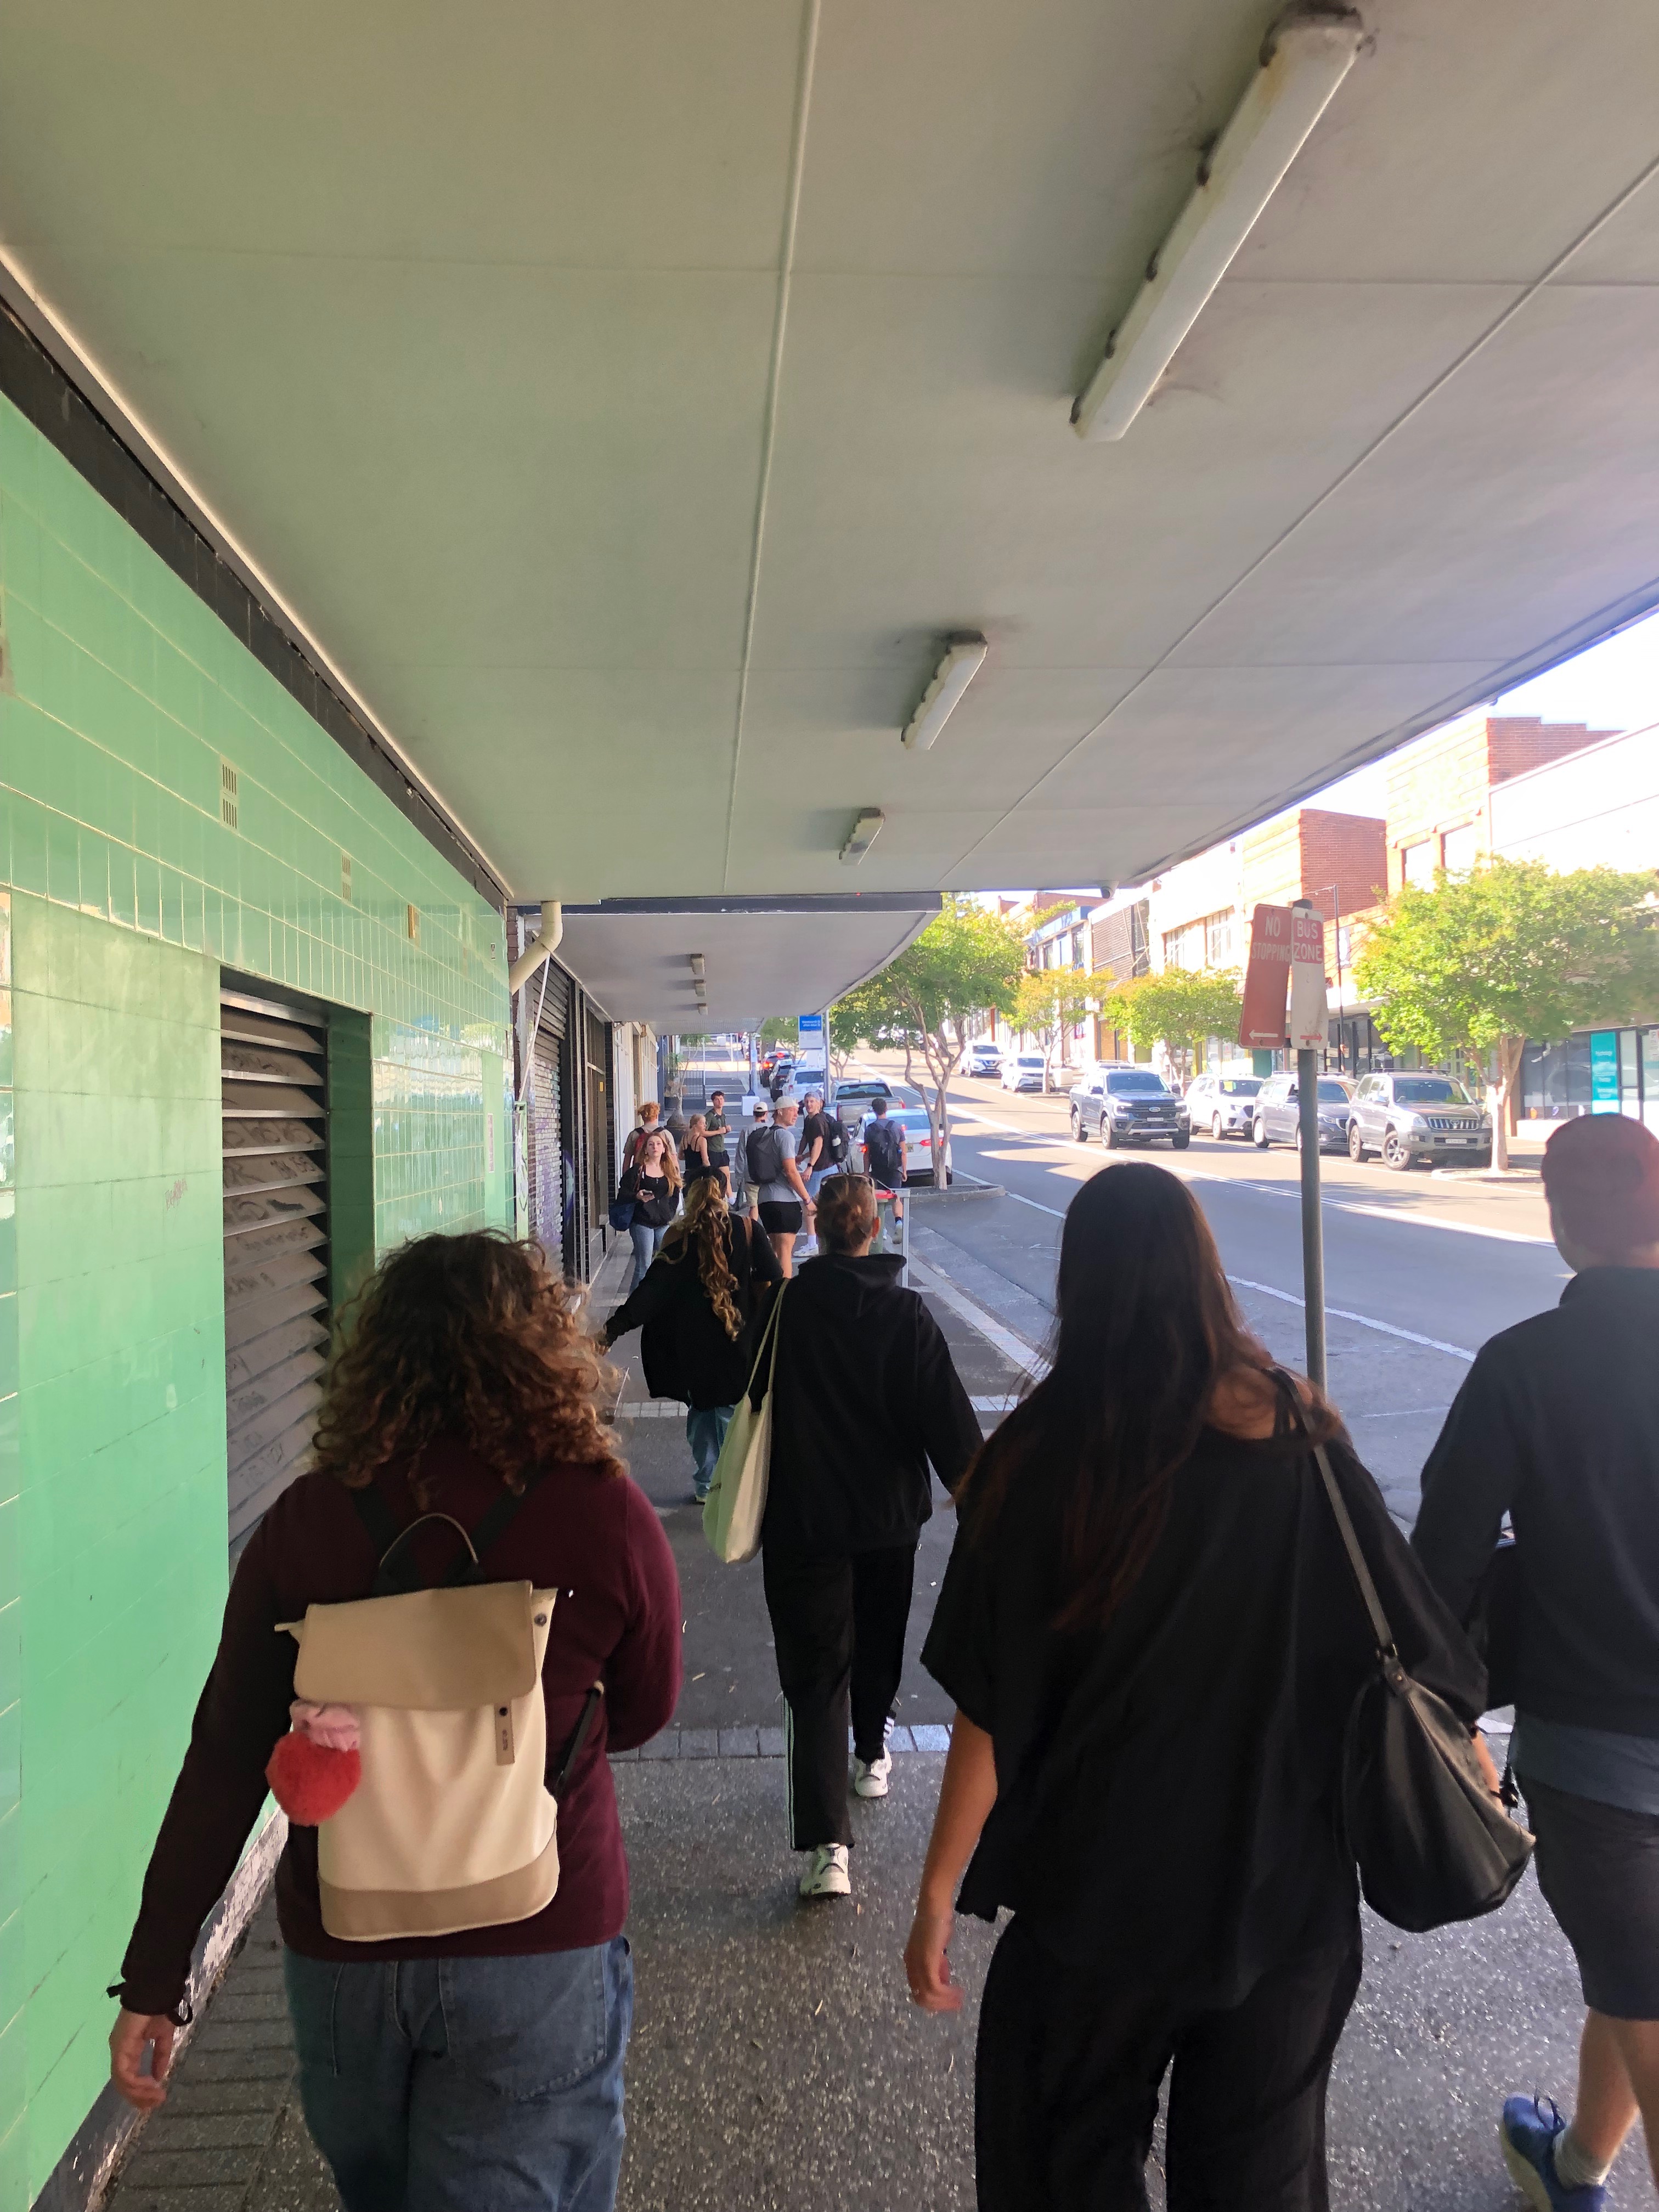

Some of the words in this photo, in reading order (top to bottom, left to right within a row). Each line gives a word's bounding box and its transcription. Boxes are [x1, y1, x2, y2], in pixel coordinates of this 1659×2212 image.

[1265, 916, 1280, 937] NO
[1297, 921, 1318, 939] BUS
[1251, 942, 1289, 962] STOPPING
[1294, 943, 1323, 962] ZONE
